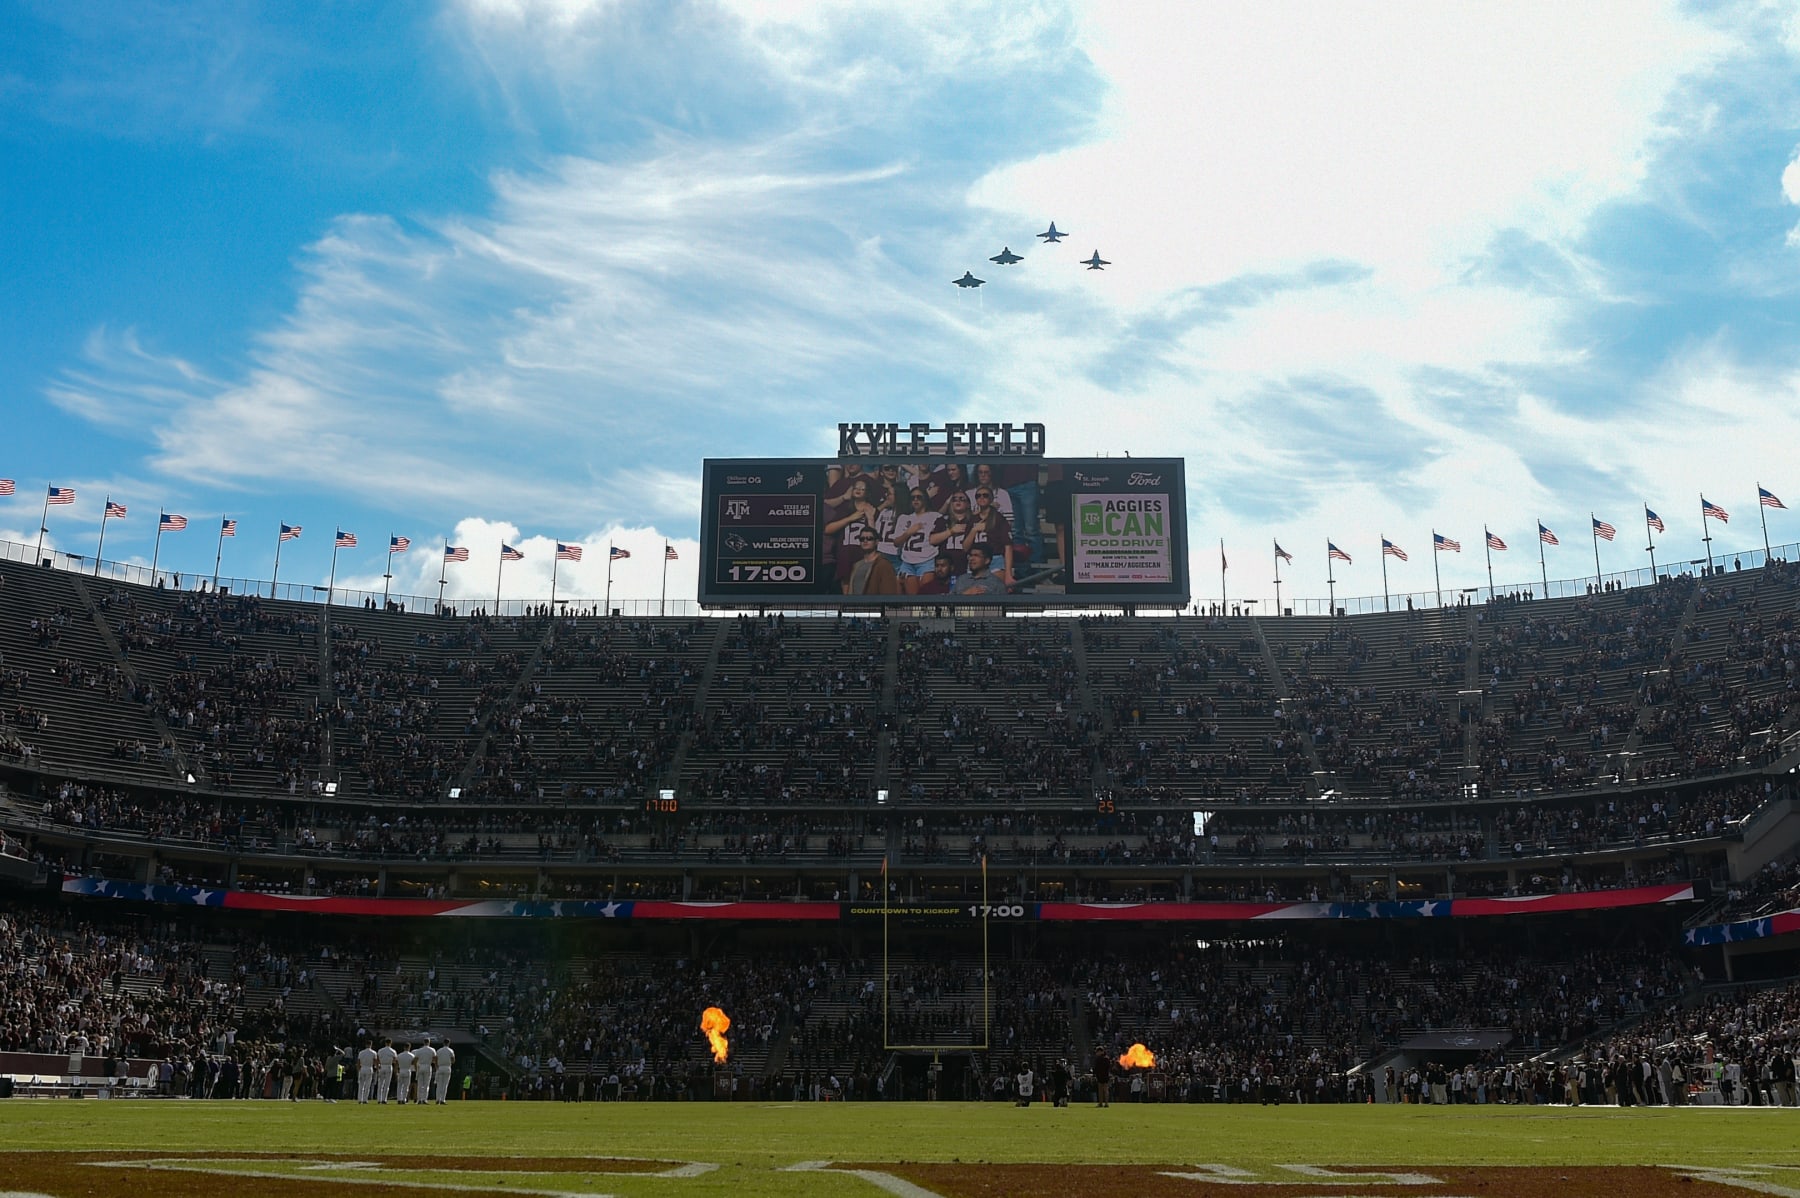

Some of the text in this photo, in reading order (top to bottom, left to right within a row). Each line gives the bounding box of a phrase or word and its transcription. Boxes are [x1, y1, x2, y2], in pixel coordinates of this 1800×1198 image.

[838, 423, 1045, 456] KYLE FIELD
[1127, 472, 1161, 486] Ford
[1105, 500, 1162, 512] AGGIES
[1105, 513, 1163, 536] CAN
[728, 566, 807, 581] 17:00
[1099, 800, 1115, 813] 25
[968, 905, 1024, 917] 17:00
